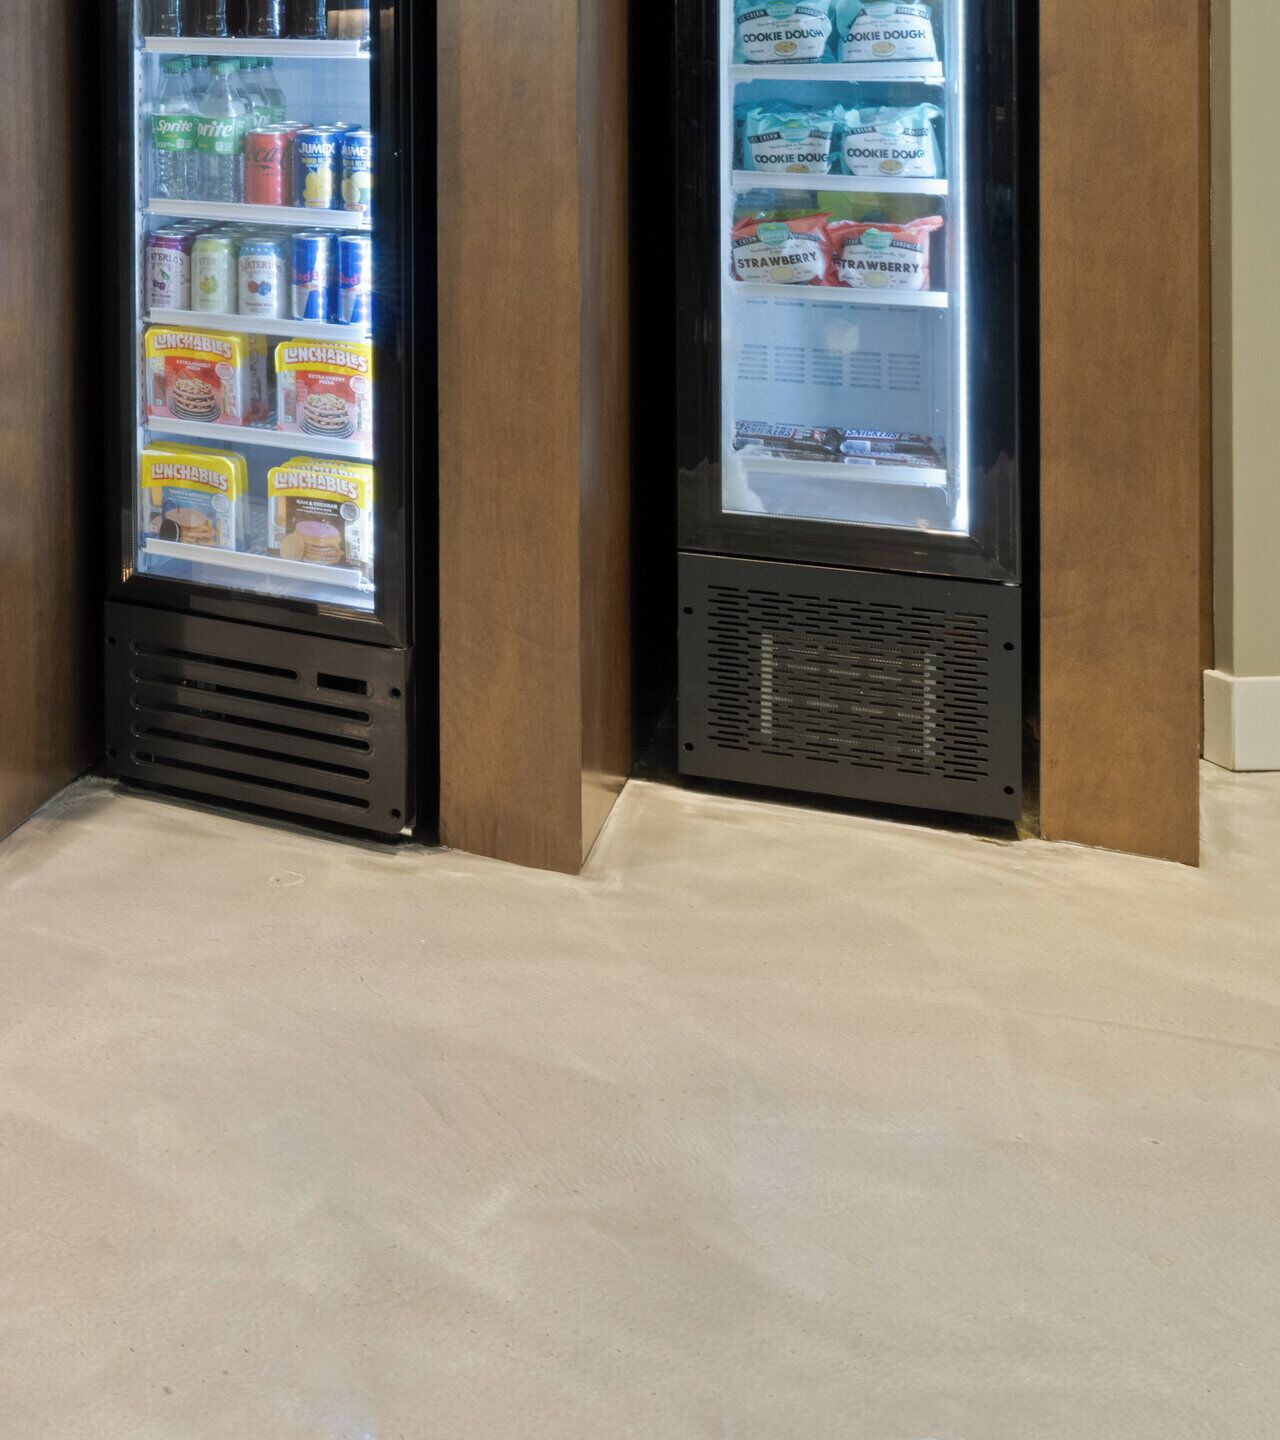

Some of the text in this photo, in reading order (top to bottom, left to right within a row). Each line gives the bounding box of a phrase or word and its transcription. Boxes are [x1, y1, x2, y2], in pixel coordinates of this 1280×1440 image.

[743, 28, 824, 43] COOKIE DOUGH
[883, 29, 926, 40] DOUGH
[156, 119, 193, 134] Sprite
[299, 142, 336, 154] JUMEX
[847, 148, 889, 159] COOKIE
[755, 153, 795, 164] COOKIE
[737, 252, 817, 269] STRAWBERRY
[153, 334, 232, 358] LUNCHABLES
[283, 347, 369, 373] LUNCHABLES
[846, 429, 899, 439] SNICKERS
[151, 463, 229, 491] LUNCHABLES
[274, 472, 359, 500] LUNCHABLES
